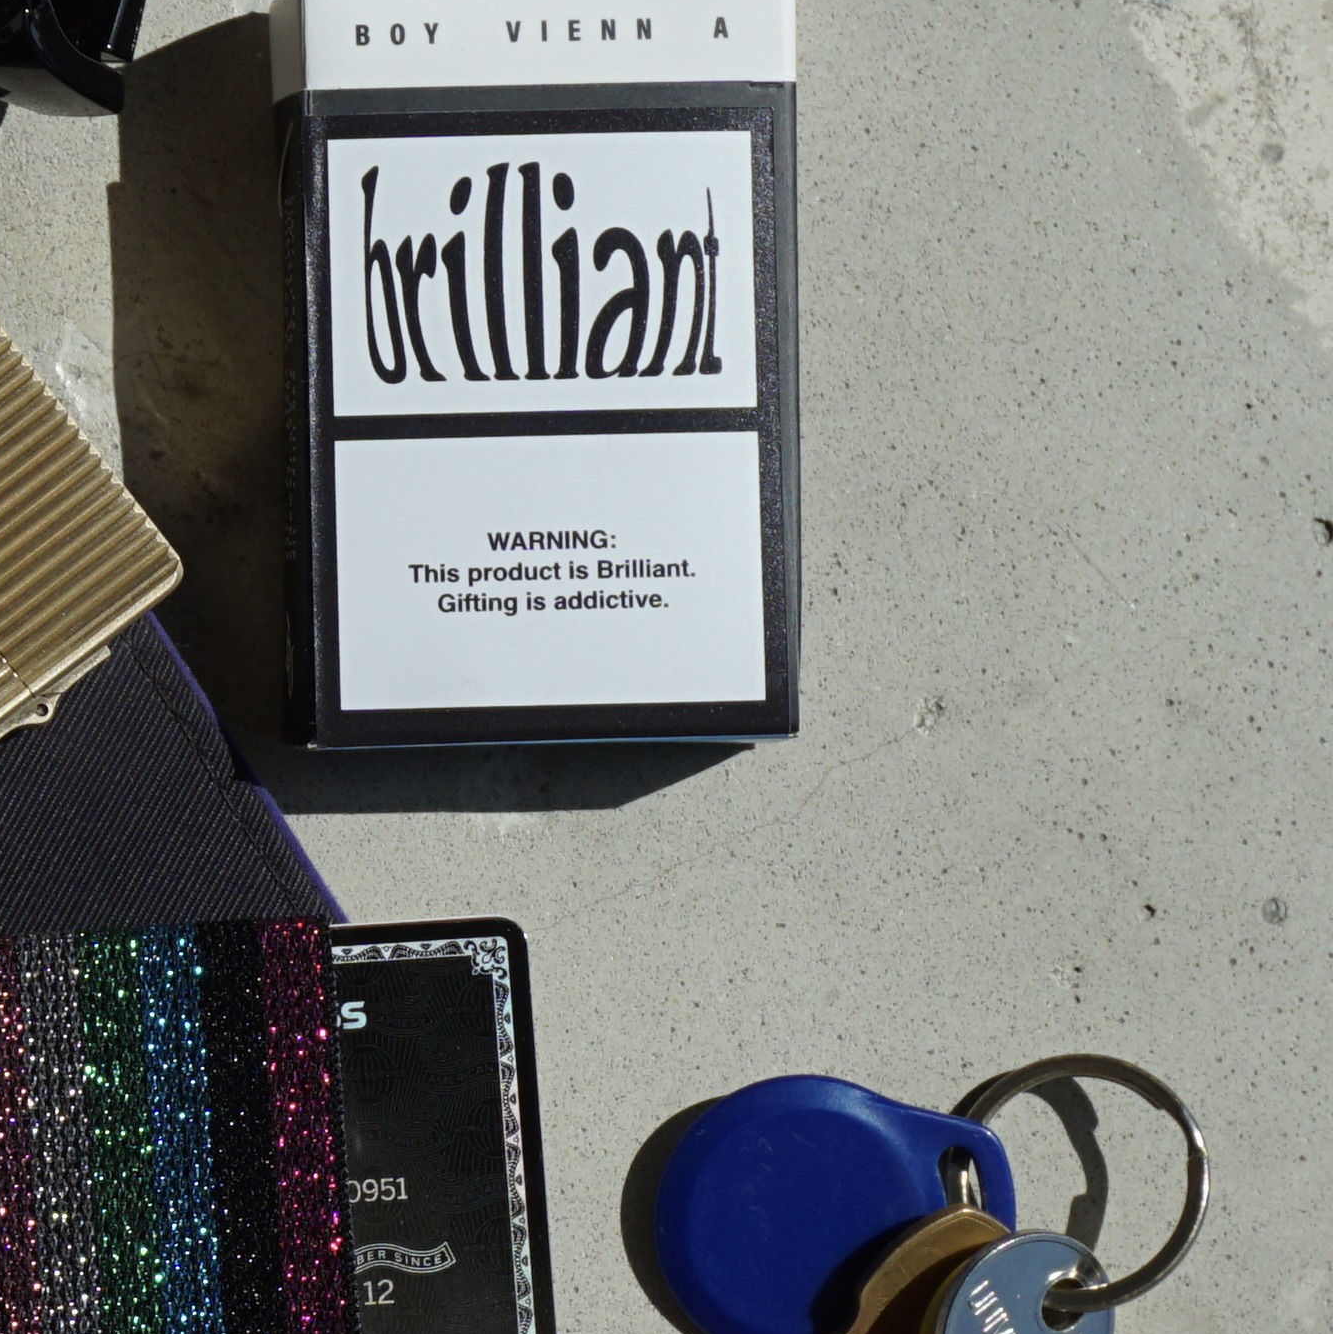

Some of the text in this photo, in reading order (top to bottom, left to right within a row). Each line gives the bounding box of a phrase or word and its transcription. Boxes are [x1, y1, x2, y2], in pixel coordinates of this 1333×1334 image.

[355, 22, 439, 46] BOY
[361, 161, 723, 385] brilliant
[487, 530, 616, 551] WARNING:
[408, 559, 696, 587] This product is Brilliant.
[438, 589, 669, 616] Gifting is addictive.
[394, 1252, 443, 1267] SINCE
[363, 1279, 395, 1306] 12
